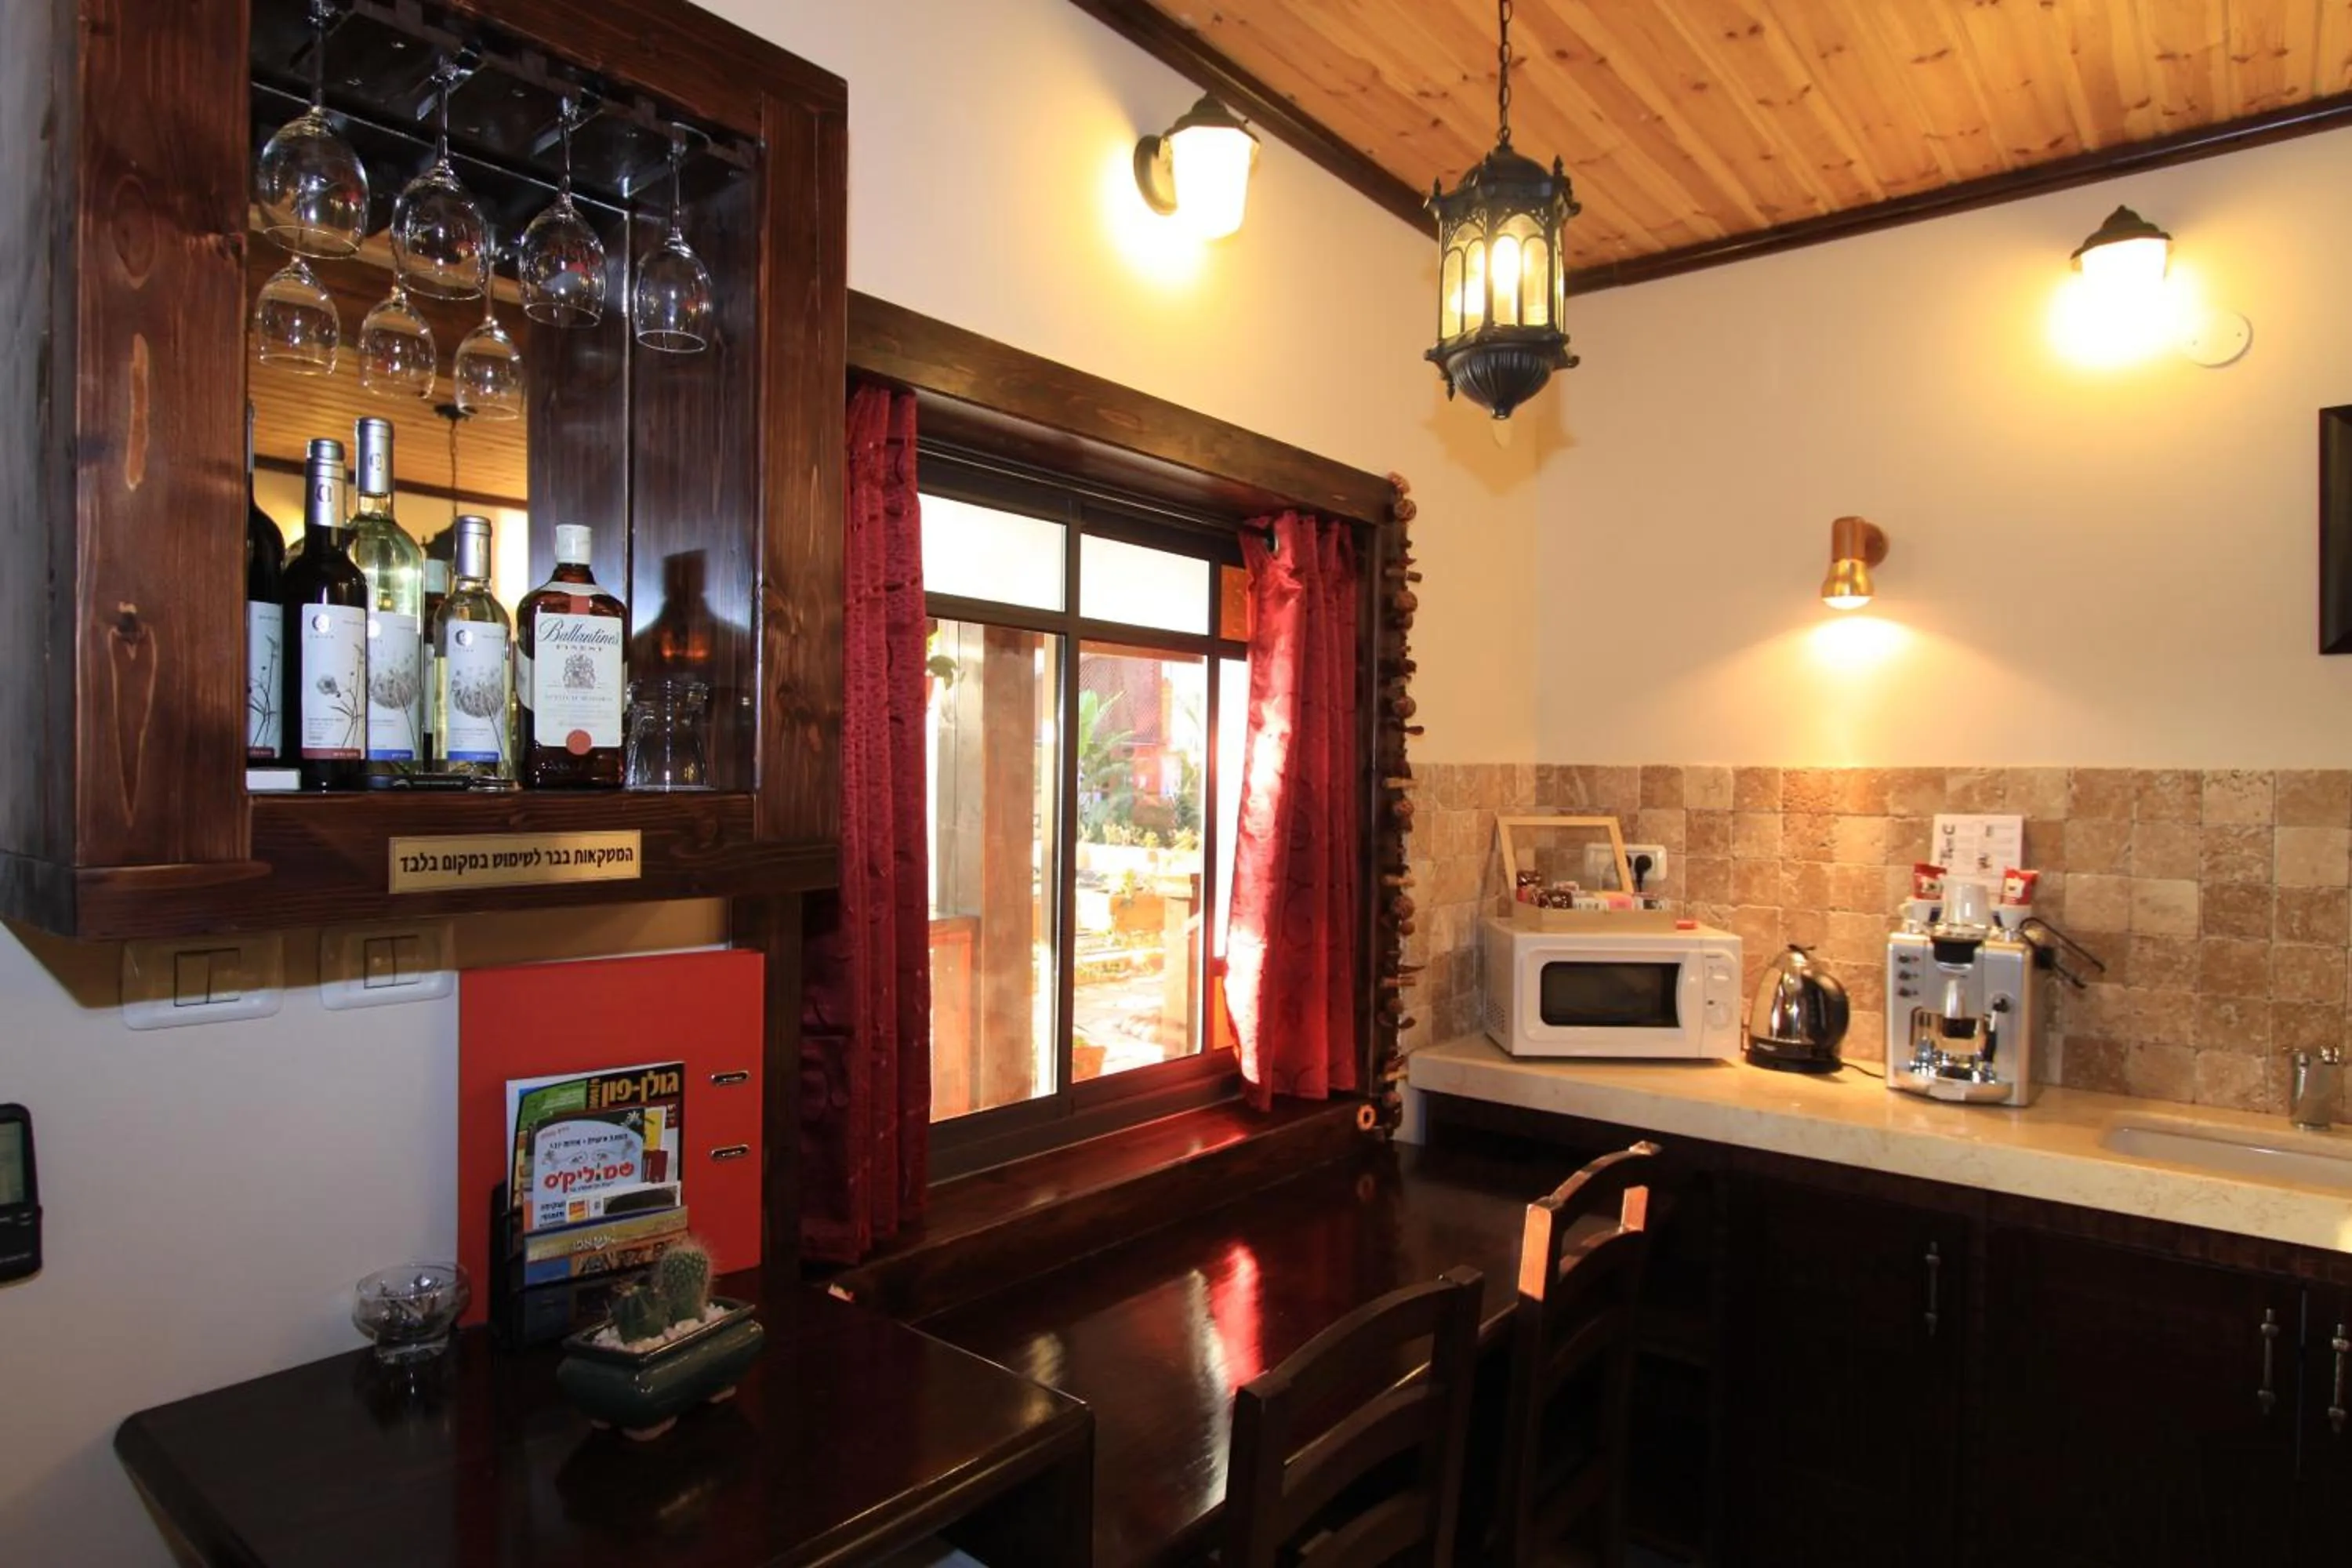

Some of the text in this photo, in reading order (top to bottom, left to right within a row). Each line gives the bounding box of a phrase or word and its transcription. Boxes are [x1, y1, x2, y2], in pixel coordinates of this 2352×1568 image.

[537, 617, 620, 645] Ballantine's
[400, 847, 633, 876] המשקאות בבר לשימוש במקום בלבד
